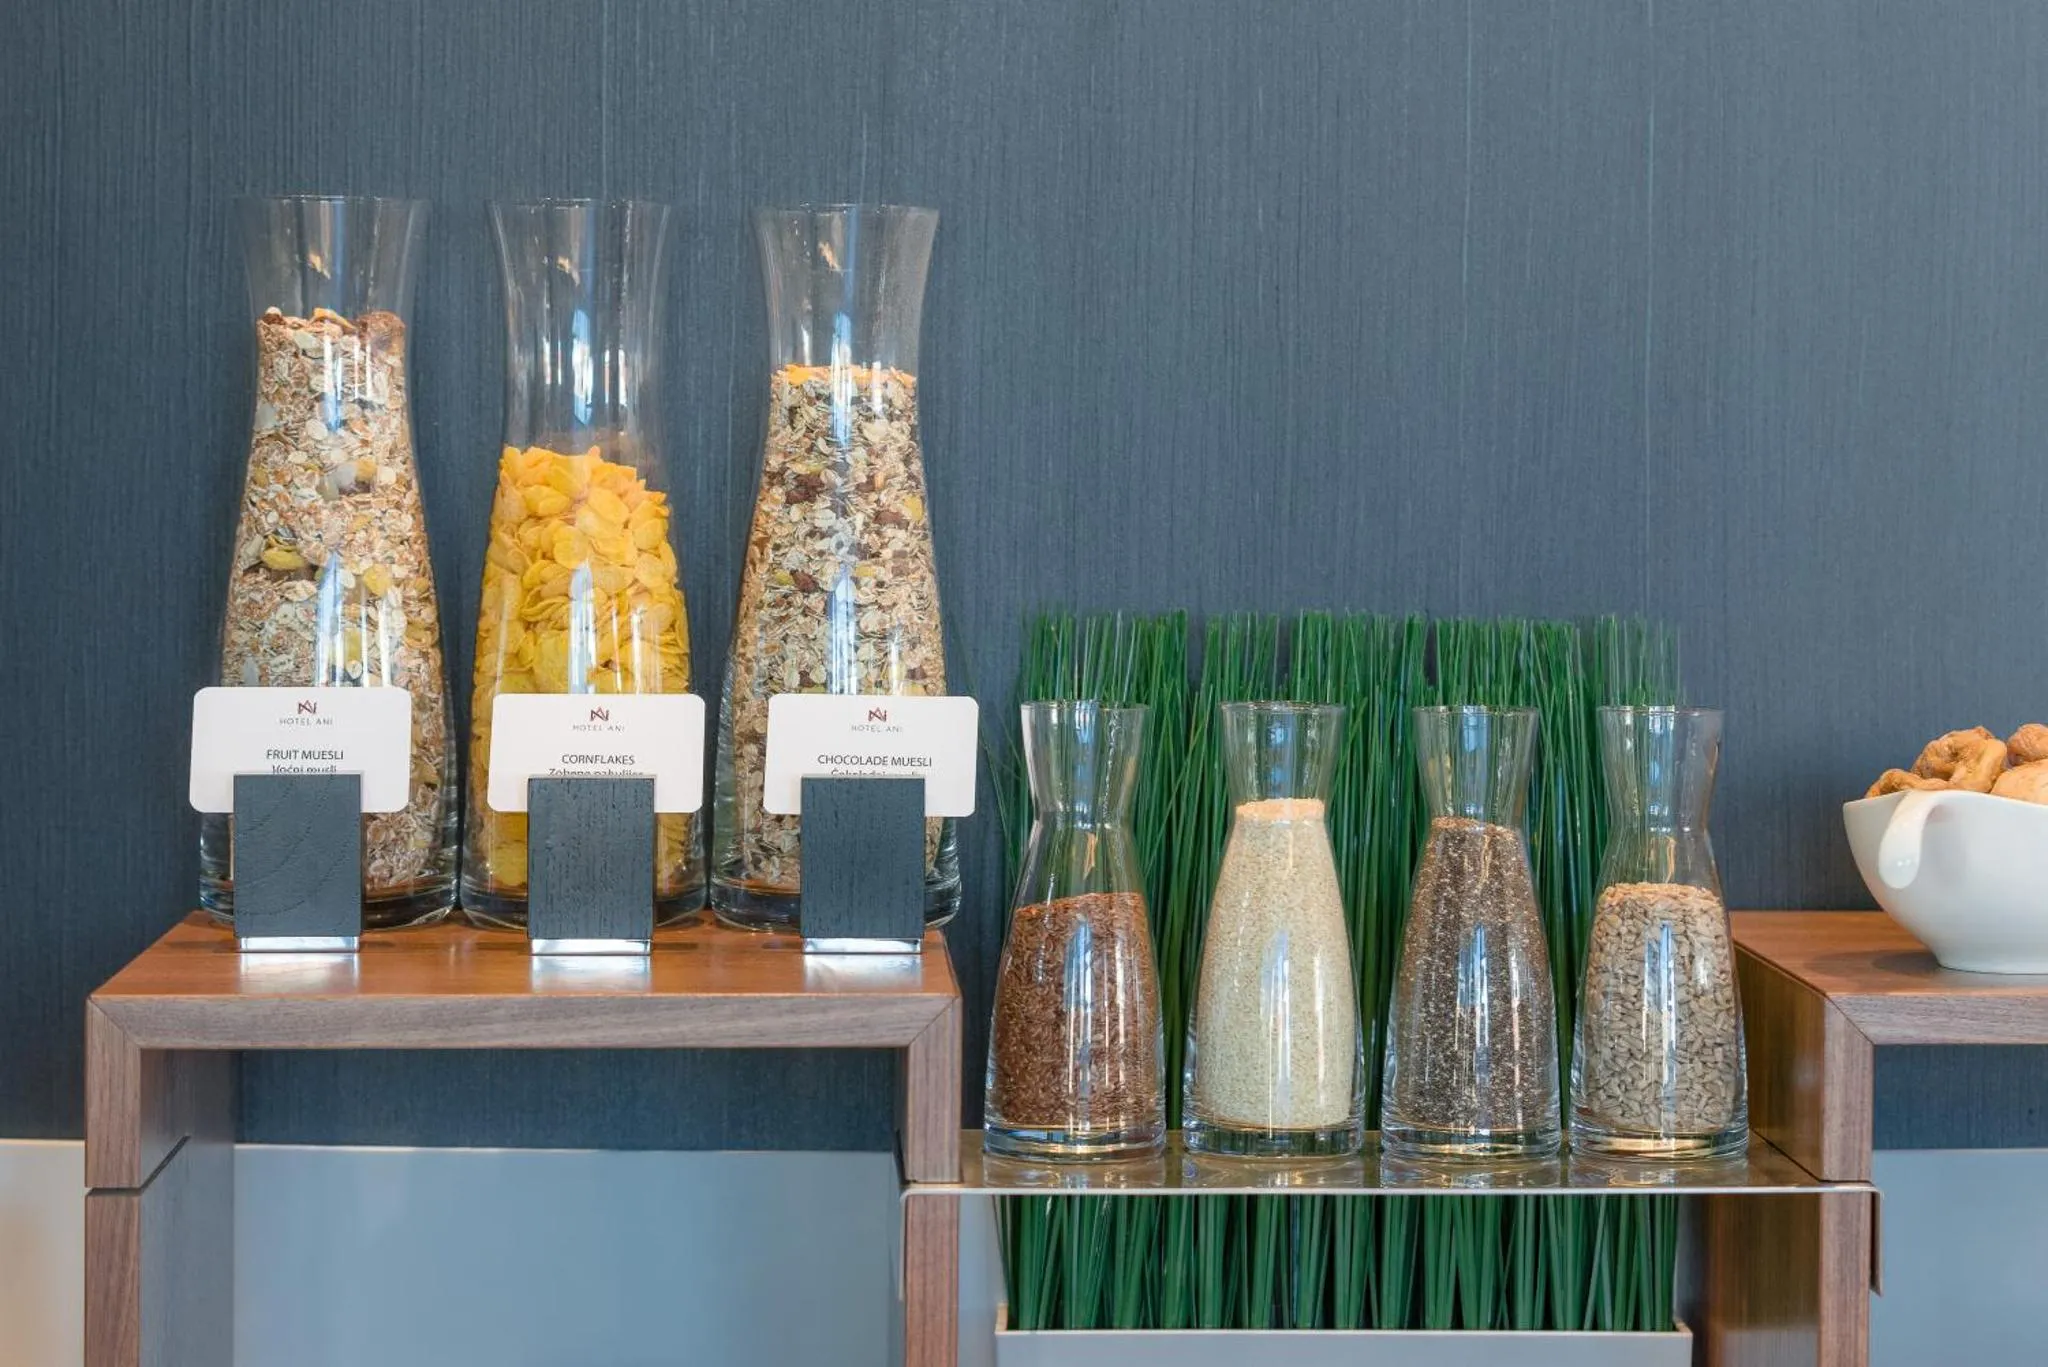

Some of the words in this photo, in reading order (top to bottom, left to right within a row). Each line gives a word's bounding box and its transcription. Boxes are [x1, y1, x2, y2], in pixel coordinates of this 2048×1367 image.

[265, 749, 299, 760] FRUIT
[301, 750, 344, 760] MUESLI
[561, 753, 636, 765] CORNFLAKES
[817, 754, 889, 766] CHOCOLADE
[891, 756, 932, 767] MUESLI
